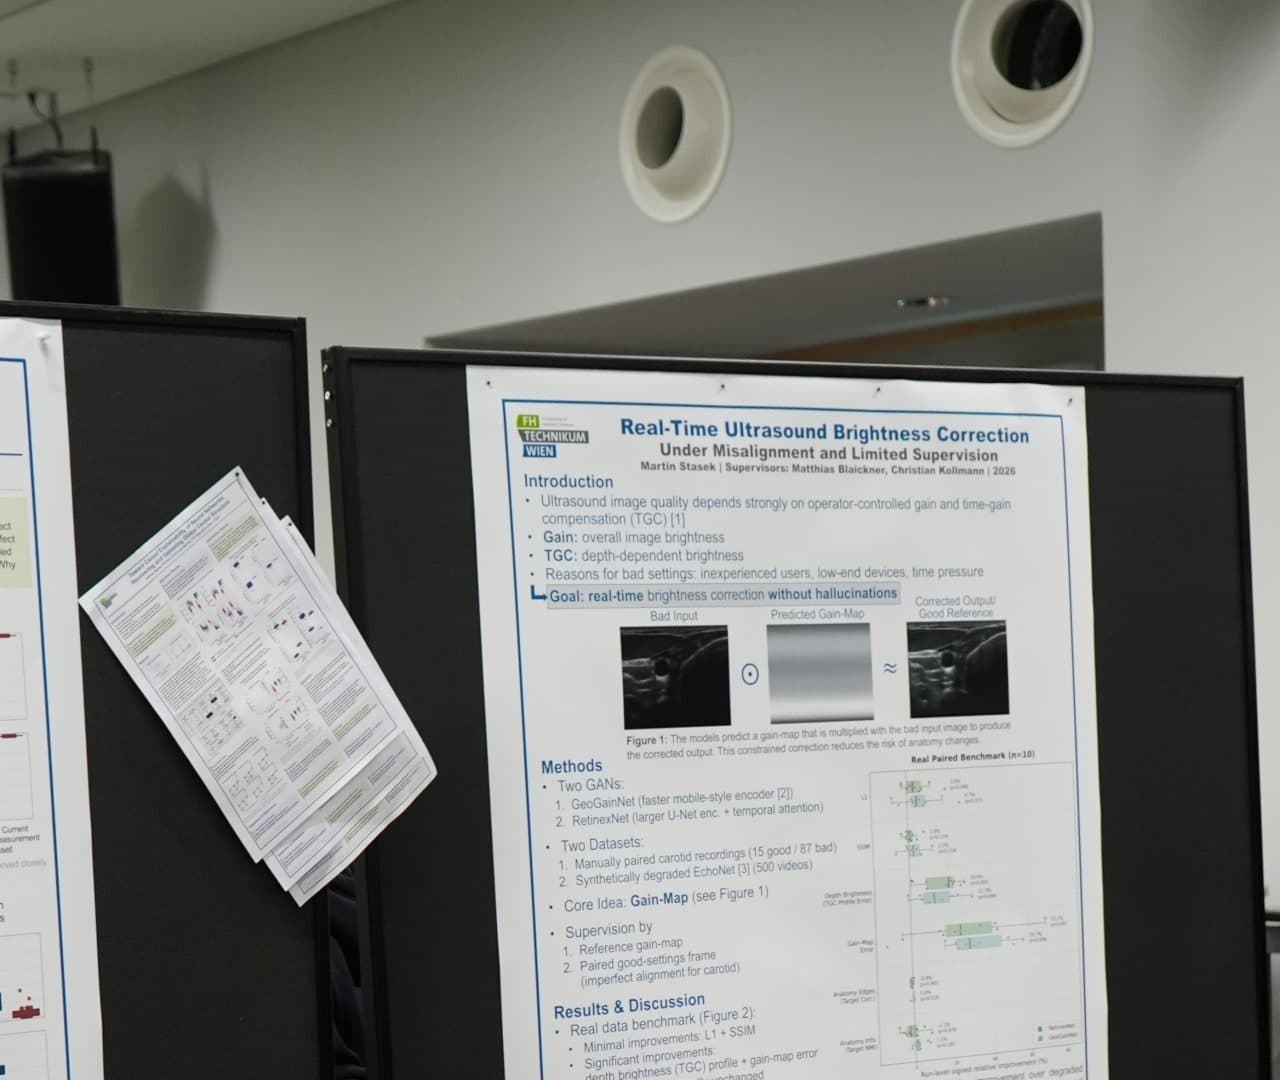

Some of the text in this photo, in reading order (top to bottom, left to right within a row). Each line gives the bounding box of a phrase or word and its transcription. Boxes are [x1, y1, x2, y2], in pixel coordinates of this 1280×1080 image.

[522, 415, 537, 427] FH
[523, 430, 587, 442] TECHNIKUM
[620, 418, 1029, 445] Real-Time Ultrasound Brightness Correction
[525, 446, 554, 457] WIEN
[659, 442, 998, 464] Under Misalignment and Limited Supervision
[640, 461, 1016, 476] Martin Stasek Supervisors: Matthias Blaickner, Christian Kollmann 2026
[524, 473, 614, 488] Introduction
[543, 530, 725, 547] Gain: overall image brightness
[543, 548, 744, 565] TGC: depth-dependent brightness
[549, 586, 898, 605] Goal: real-time brightness correction without hallucinations
[649, 609, 698, 623] Bad Input
[770, 607, 865, 620] Predicted Gain-Map
[918, 607, 994, 619] Good Reference
[626, 735, 657, 748] Figure
[541, 758, 603, 774] Methods
[556, 777, 624, 792] Two GANs:
[563, 885, 769, 912] Core Idea: Gain-Map (see Figure 1)
[553, 993, 705, 1020] Results & Discussion
